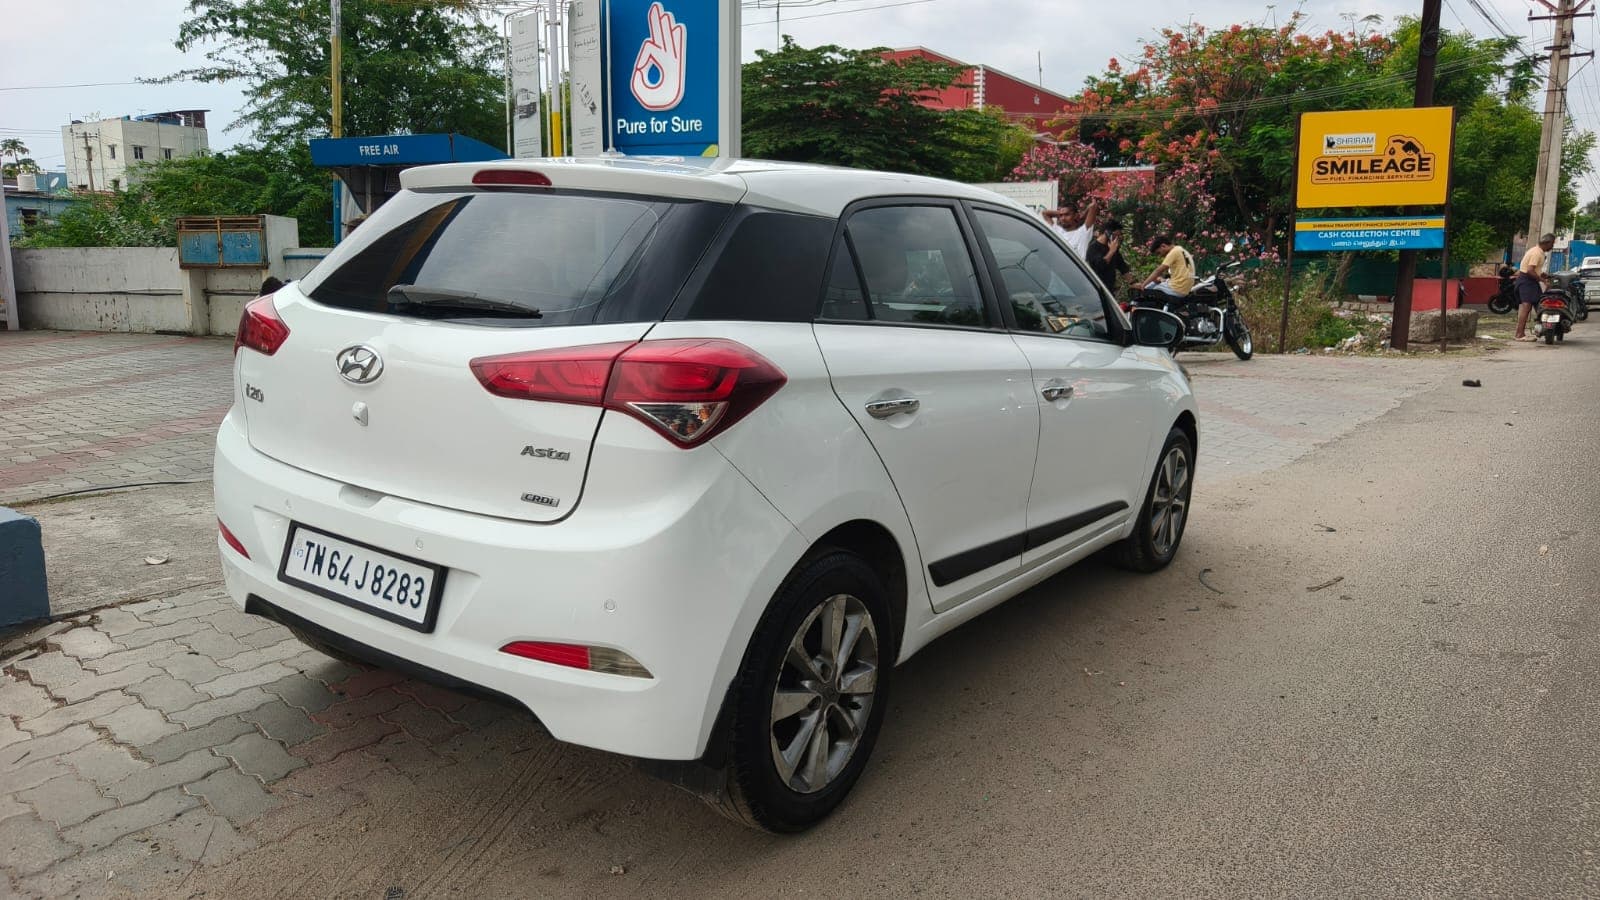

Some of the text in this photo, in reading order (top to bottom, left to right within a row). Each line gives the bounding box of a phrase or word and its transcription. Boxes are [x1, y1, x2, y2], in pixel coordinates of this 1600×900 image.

[617, 116, 703, 134] Pure for Sure
[1336, 136, 1375, 145] SHRIRAM
[359, 144, 400, 156] FREE AIR
[1316, 156, 1431, 175] SMILEAGE
[1318, 229, 1421, 239] CASH COLLECTION CENTRE
[246, 383, 264, 403] i20
[520, 446, 571, 461] Asta
